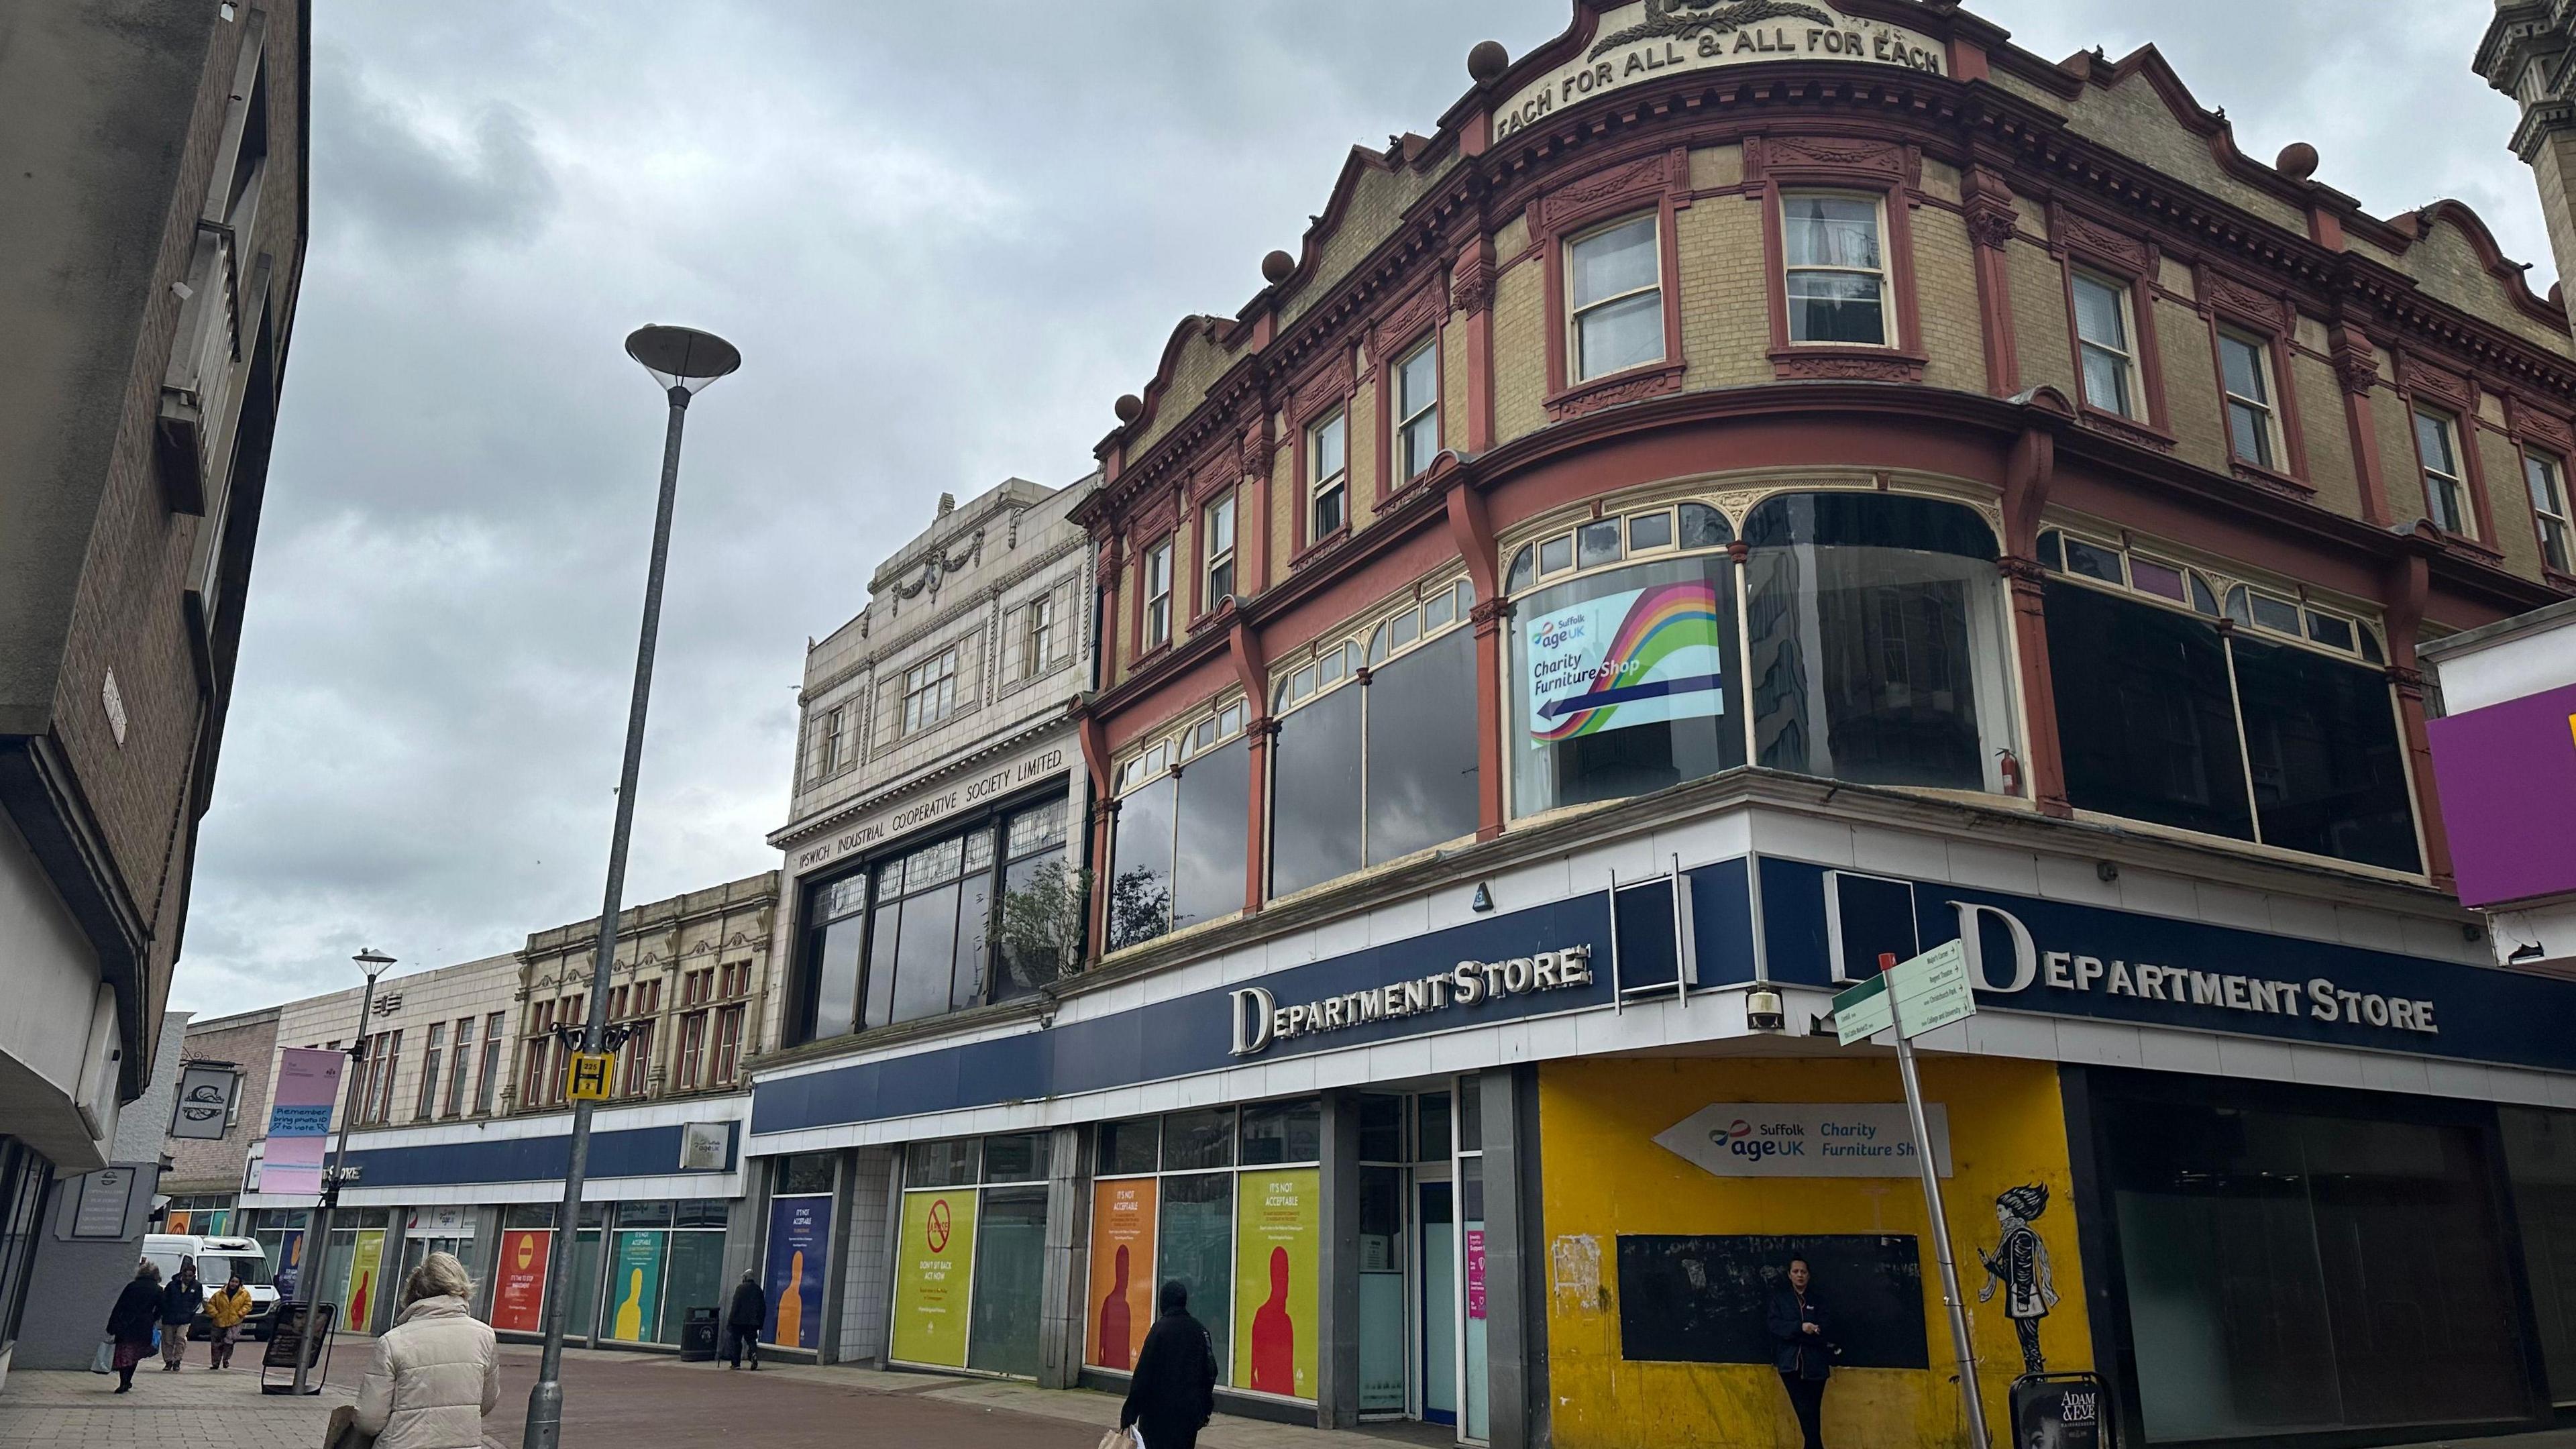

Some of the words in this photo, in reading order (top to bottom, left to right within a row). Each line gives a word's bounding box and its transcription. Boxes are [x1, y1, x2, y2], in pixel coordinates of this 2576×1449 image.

[1497, 89, 1552, 141] EACH
[1562, 61, 1614, 103] FOR
[1624, 42, 1685, 78] ALL
[1698, 35, 1721, 58] &
[1733, 28, 1796, 54] ALL
[1807, 28, 1864, 56] FOR
[1873, 36, 1939, 75] EACH
[1558, 614, 1585, 629] Suffolk
[1534, 653, 1582, 678] Charity
[1535, 667, 1597, 696] Furniture
[1601, 658, 1640, 678] Shop
[799, 843, 830, 869] IPSWICH
[837, 822, 884, 853] INDUSTRIAL
[966, 769, 1010, 802] SOCIETY
[1228, 971, 1454, 1056] DEPARTMENT
[1454, 943, 1593, 1006] STORE
[2307, 978, 2438, 1034] STORE
[584, 1063, 597, 1071] 225
[585, 1082, 590, 1090] 2
[276, 1108, 327, 1116] Remember
[274, 1115, 293, 1124] bring
[294, 1116, 318, 1124] photo
[1760, 1123, 1805, 1136] Suffolk
[1821, 1122, 1877, 1140] Charity
[1822, 1142, 1892, 1157] Furniture
[1269, 1183, 1279, 1193] IT'S
[1280, 1182, 1293, 1193] NOT
[1124, 1190, 1134, 1199] NOT
[1114, 1201, 1138, 1211] ACCEPTABLE
[1265, 1196, 1299, 1207] ACCEPTABLE
[940, 1262, 952, 1270] BACK
[924, 1272, 934, 1280] ACT
[2061, 1390, 2096, 1407] ADAM
